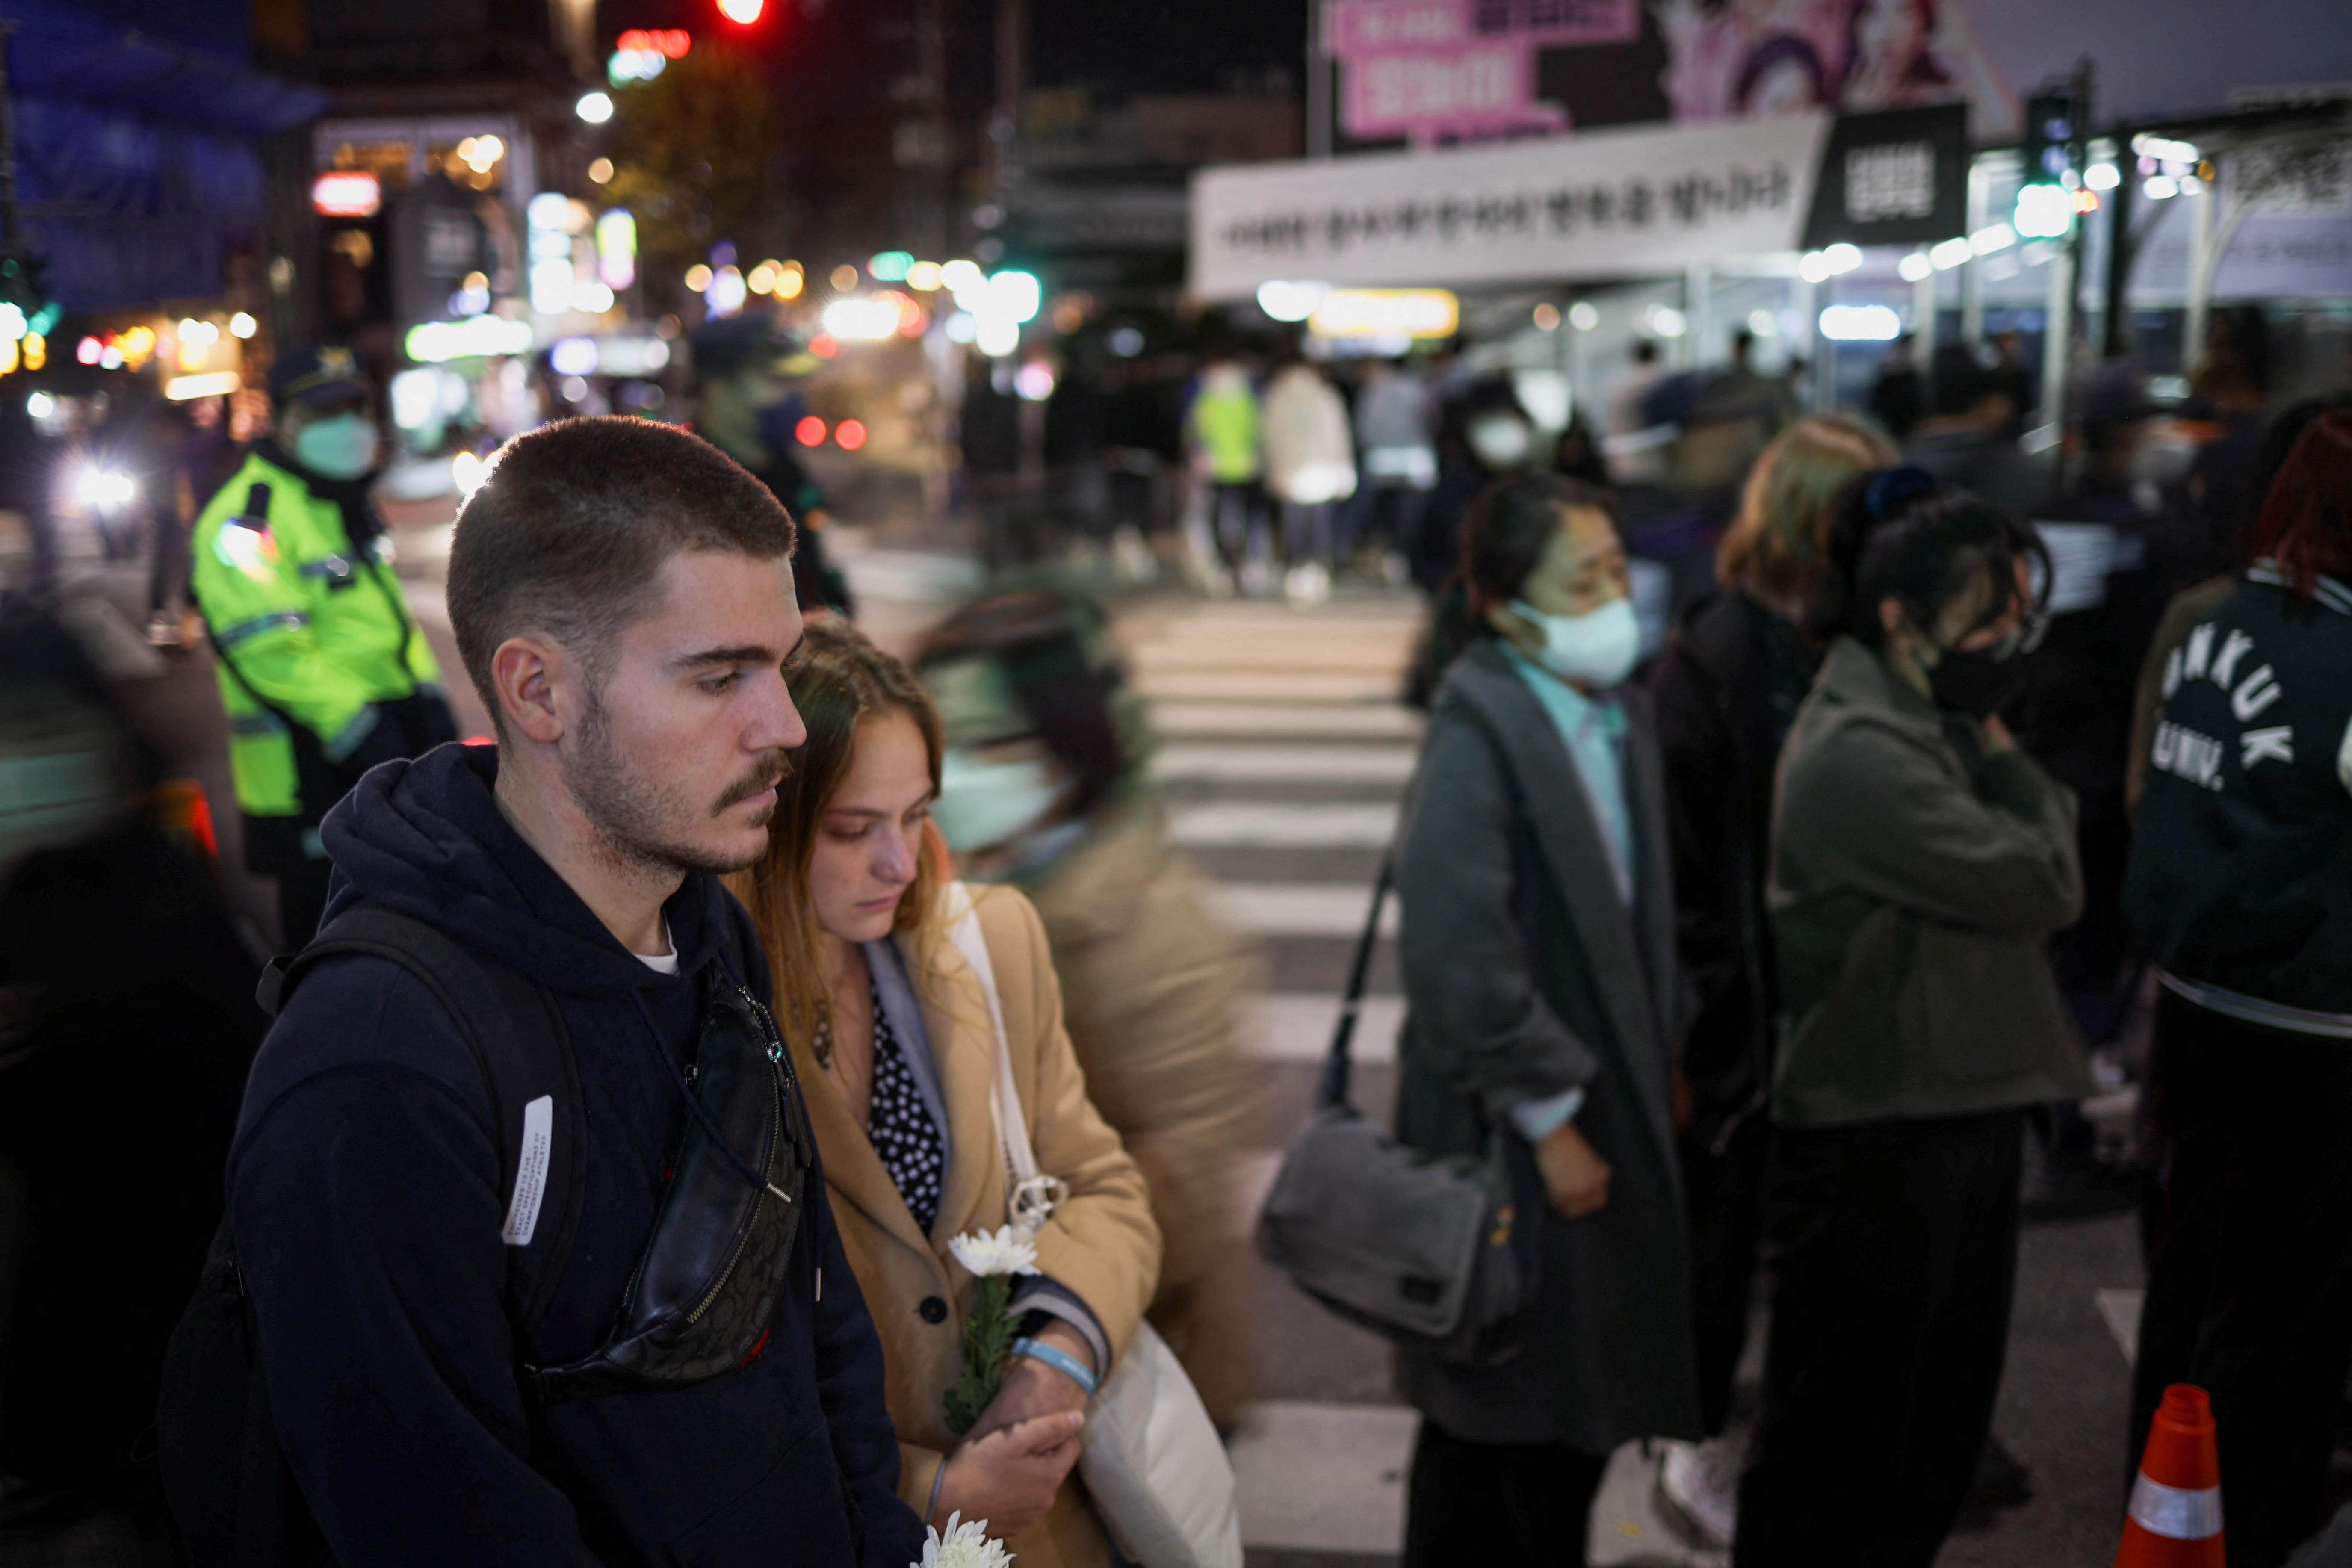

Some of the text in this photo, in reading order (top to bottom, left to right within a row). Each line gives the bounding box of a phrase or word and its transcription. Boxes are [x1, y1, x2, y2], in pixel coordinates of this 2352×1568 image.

[515, 1133, 540, 1236] EXACT SPECIFICATIONS OF
[522, 1175, 528, 1184] TO
[522, 1135, 547, 1236] CHAMPIONSHIP ATHLETES
